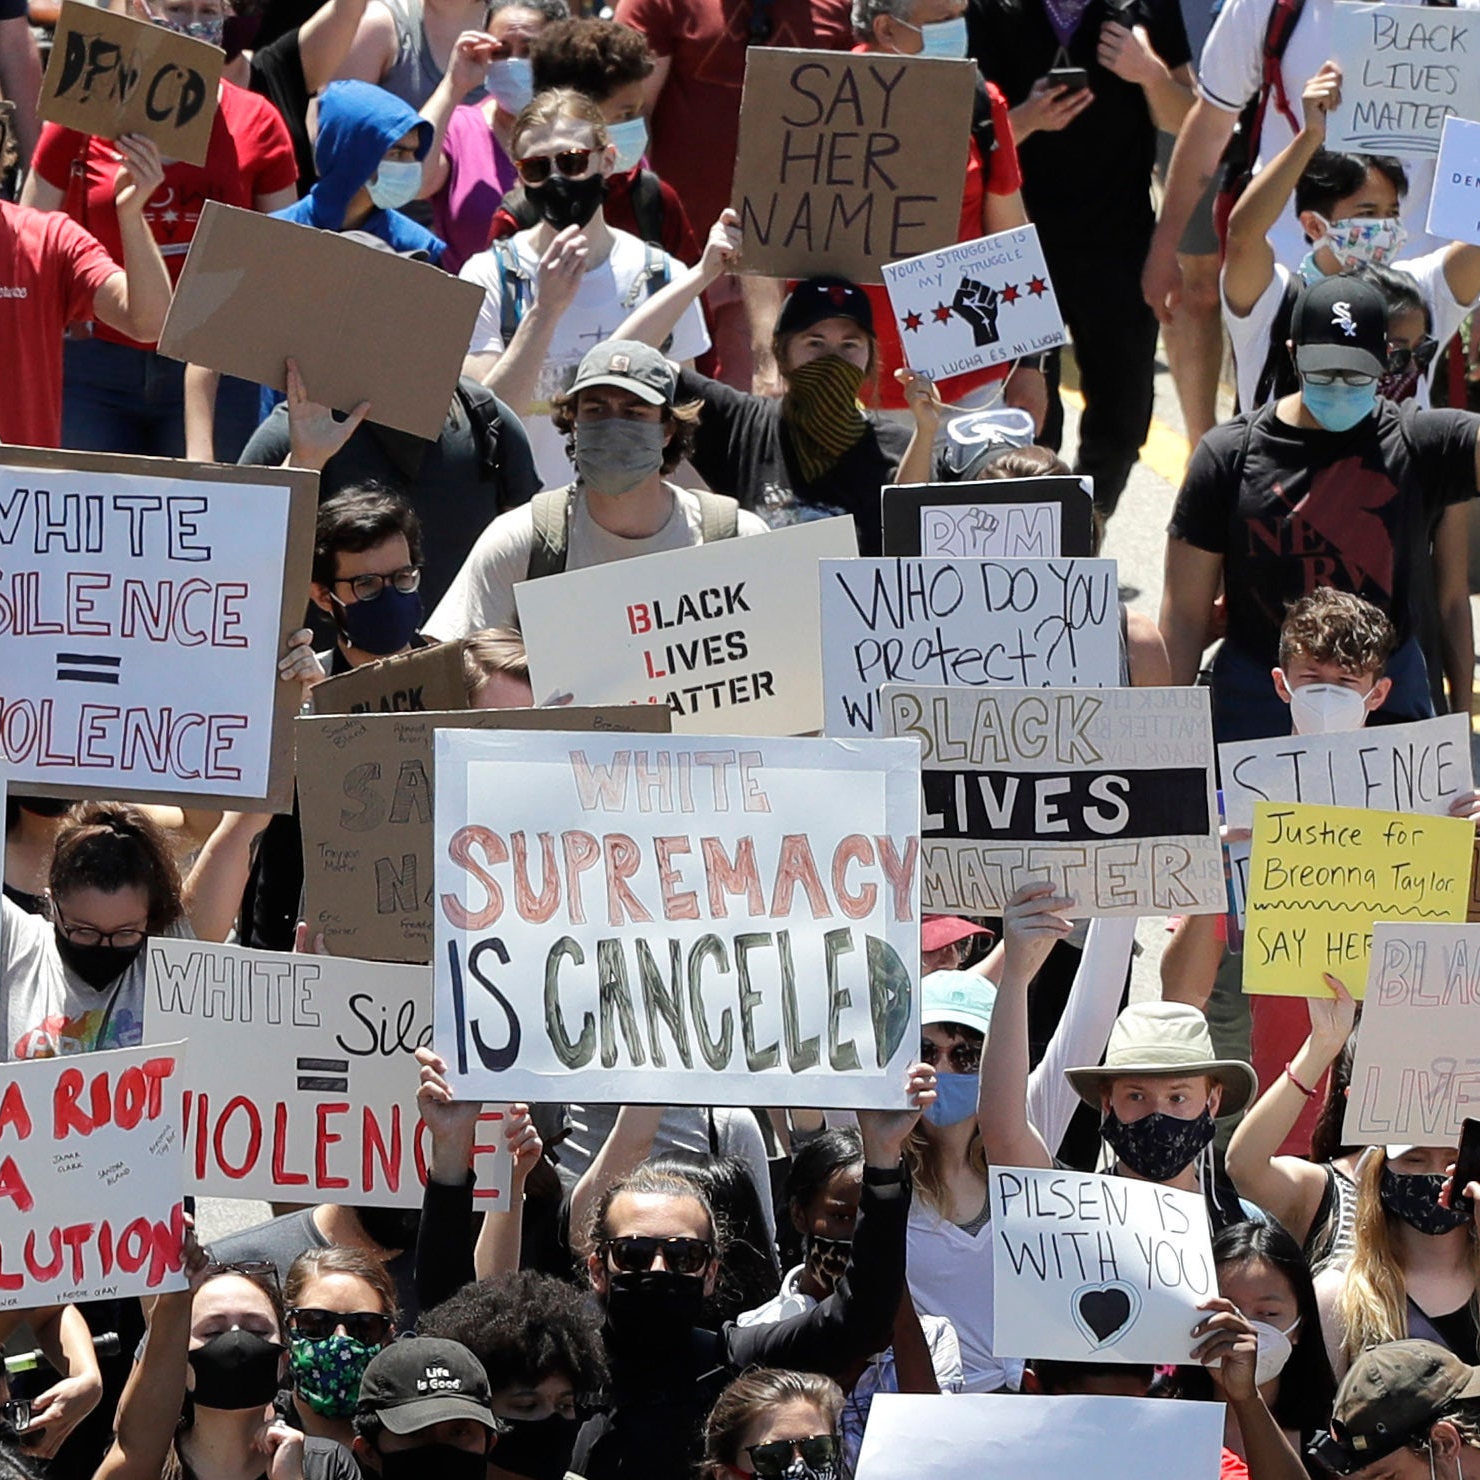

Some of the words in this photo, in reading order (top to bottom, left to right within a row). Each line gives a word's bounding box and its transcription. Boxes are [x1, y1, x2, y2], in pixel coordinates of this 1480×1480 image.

[1371, 14, 1469, 53] BLACK
[782, 63, 907, 131] SAY
[1363, 60, 1460, 95] LIVES
[780, 131, 901, 191] HER
[741, 194, 939, 259] NAME
[888, 261, 926, 283] YOUR
[935, 237, 1003, 269] STRUGGLE
[1011, 232, 1027, 244] IS
[918, 273, 945, 288] MY
[959, 248, 1023, 278] STRUGGLE
[941, 354, 984, 374] LUCHA
[1032, 331, 1064, 350] LUCHA
[627, 582, 752, 635] BLACK
[835, 558, 965, 631] WHO
[980, 562, 1039, 613] DO
[1047, 559, 1110, 630] YOU
[643, 629, 751, 681] LIVES
[568, 749, 773, 815] WHITE
[1265, 810, 1361, 849] Justice
[1382, 821, 1426, 845] for
[439, 824, 919, 933] SUPREMACY
[1262, 857, 1377, 894] Breonna
[151, 946, 322, 1029] WHITE
[446, 935, 523, 1076] IS
[543, 926, 912, 1073] CANCELED
[53, 1056, 177, 1141] RIOT
[997, 1171, 1136, 1230] PILSEN
[1156, 1190, 1192, 1235] IS
[1001, 1229, 1121, 1284] WITH
[1141, 1234, 1210, 1299] YOU
[424, 1366, 450, 1381] Life
[432, 1376, 462, 1391] Good
